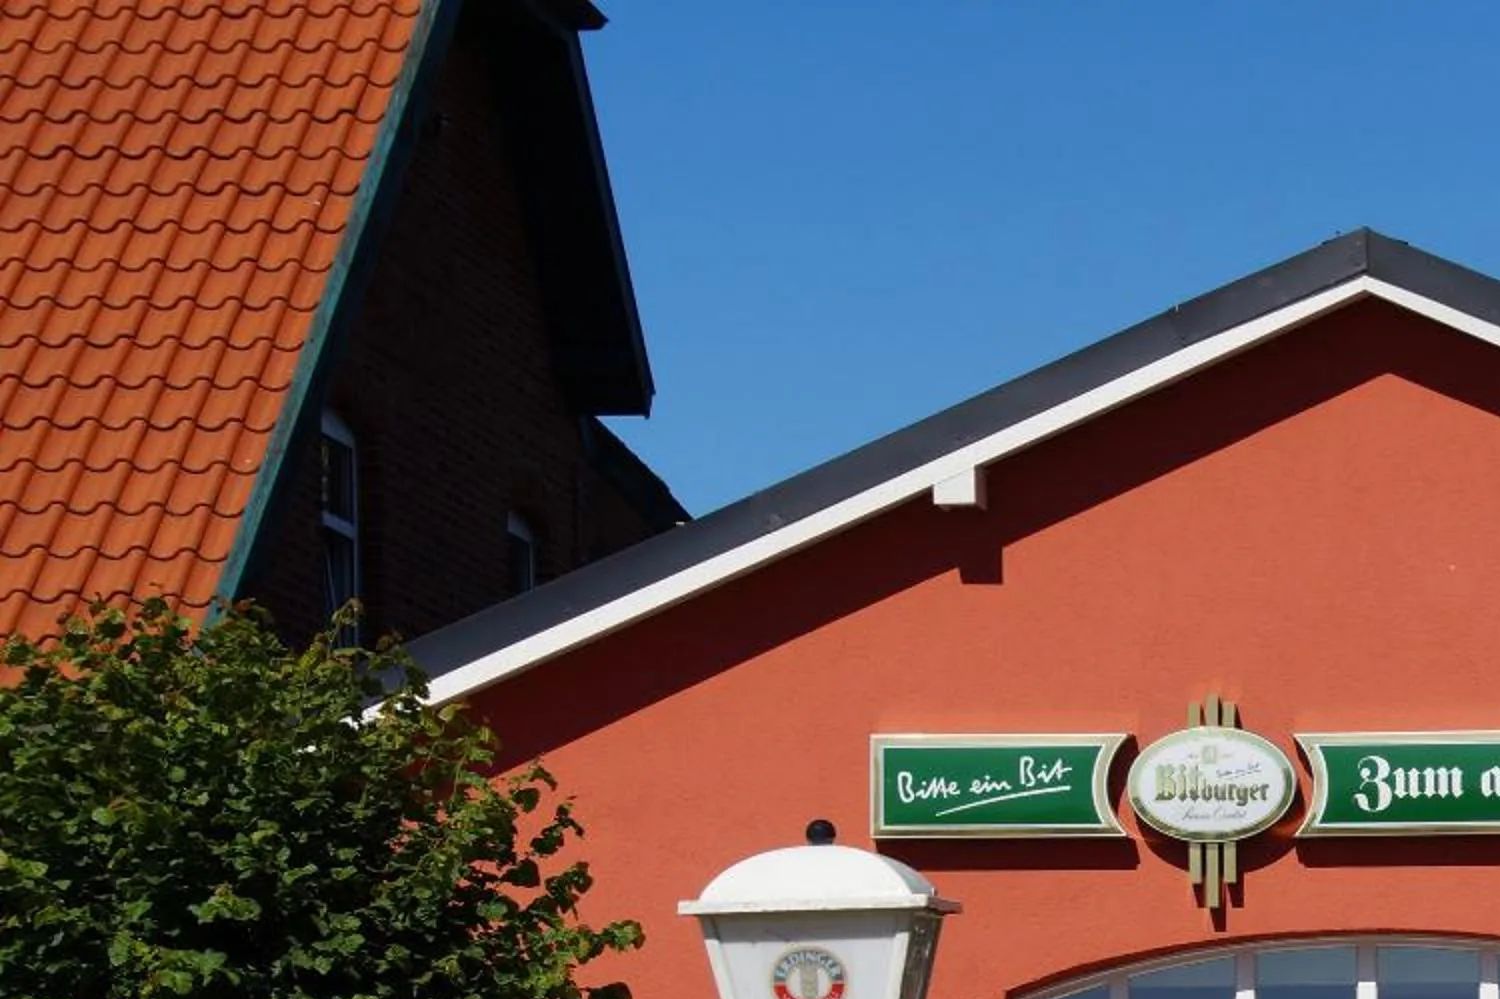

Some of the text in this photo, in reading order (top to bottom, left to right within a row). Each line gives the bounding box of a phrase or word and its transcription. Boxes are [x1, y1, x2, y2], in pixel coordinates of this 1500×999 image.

[897, 755, 1073, 804] Bitte ein Bit
[1154, 763, 1270, 807] Bitburger
[1353, 755, 1465, 813] Zum
